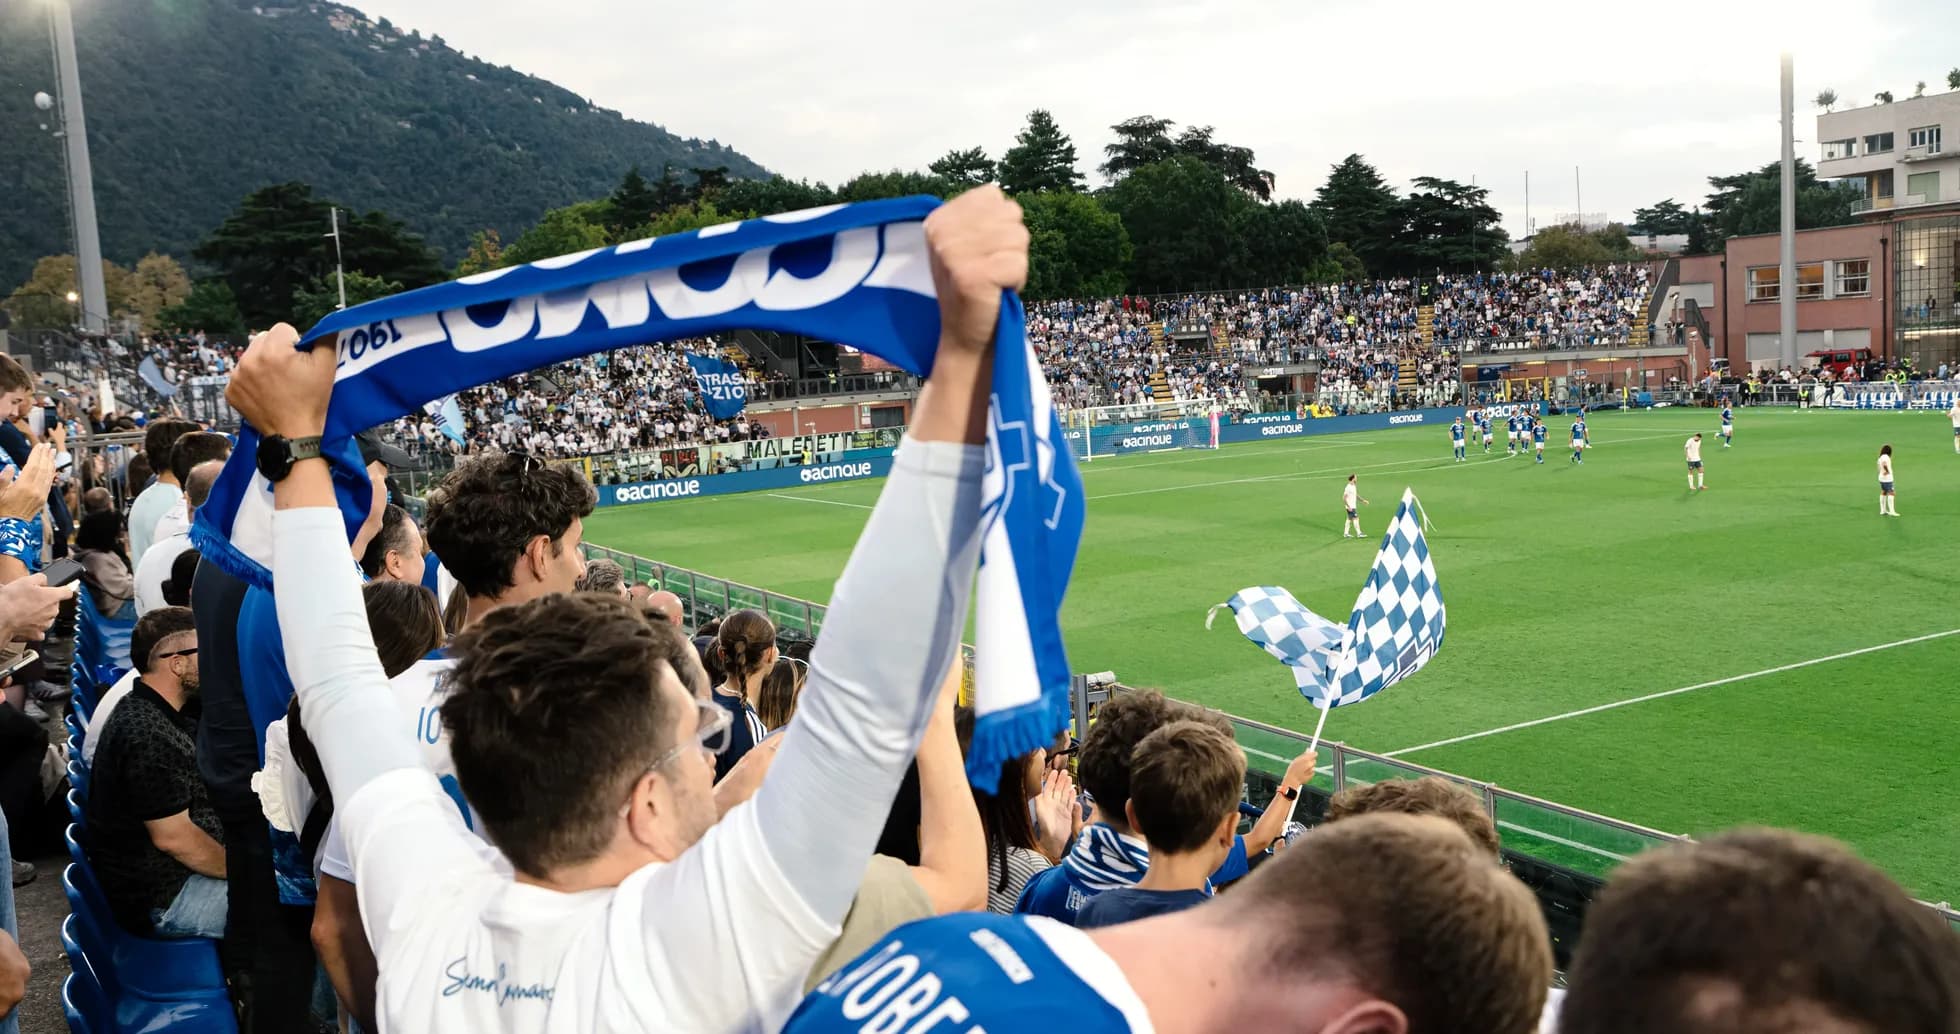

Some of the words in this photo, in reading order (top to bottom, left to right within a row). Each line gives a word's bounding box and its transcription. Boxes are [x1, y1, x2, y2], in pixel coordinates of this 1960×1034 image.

[697, 370, 742, 386] TRAS
[707, 386, 745, 400] ZIO
[1269, 424, 1303, 434] acinque
[1131, 434, 1172, 447] acinque
[811, 462, 872, 480] acinque
[629, 480, 700, 500] acinque
